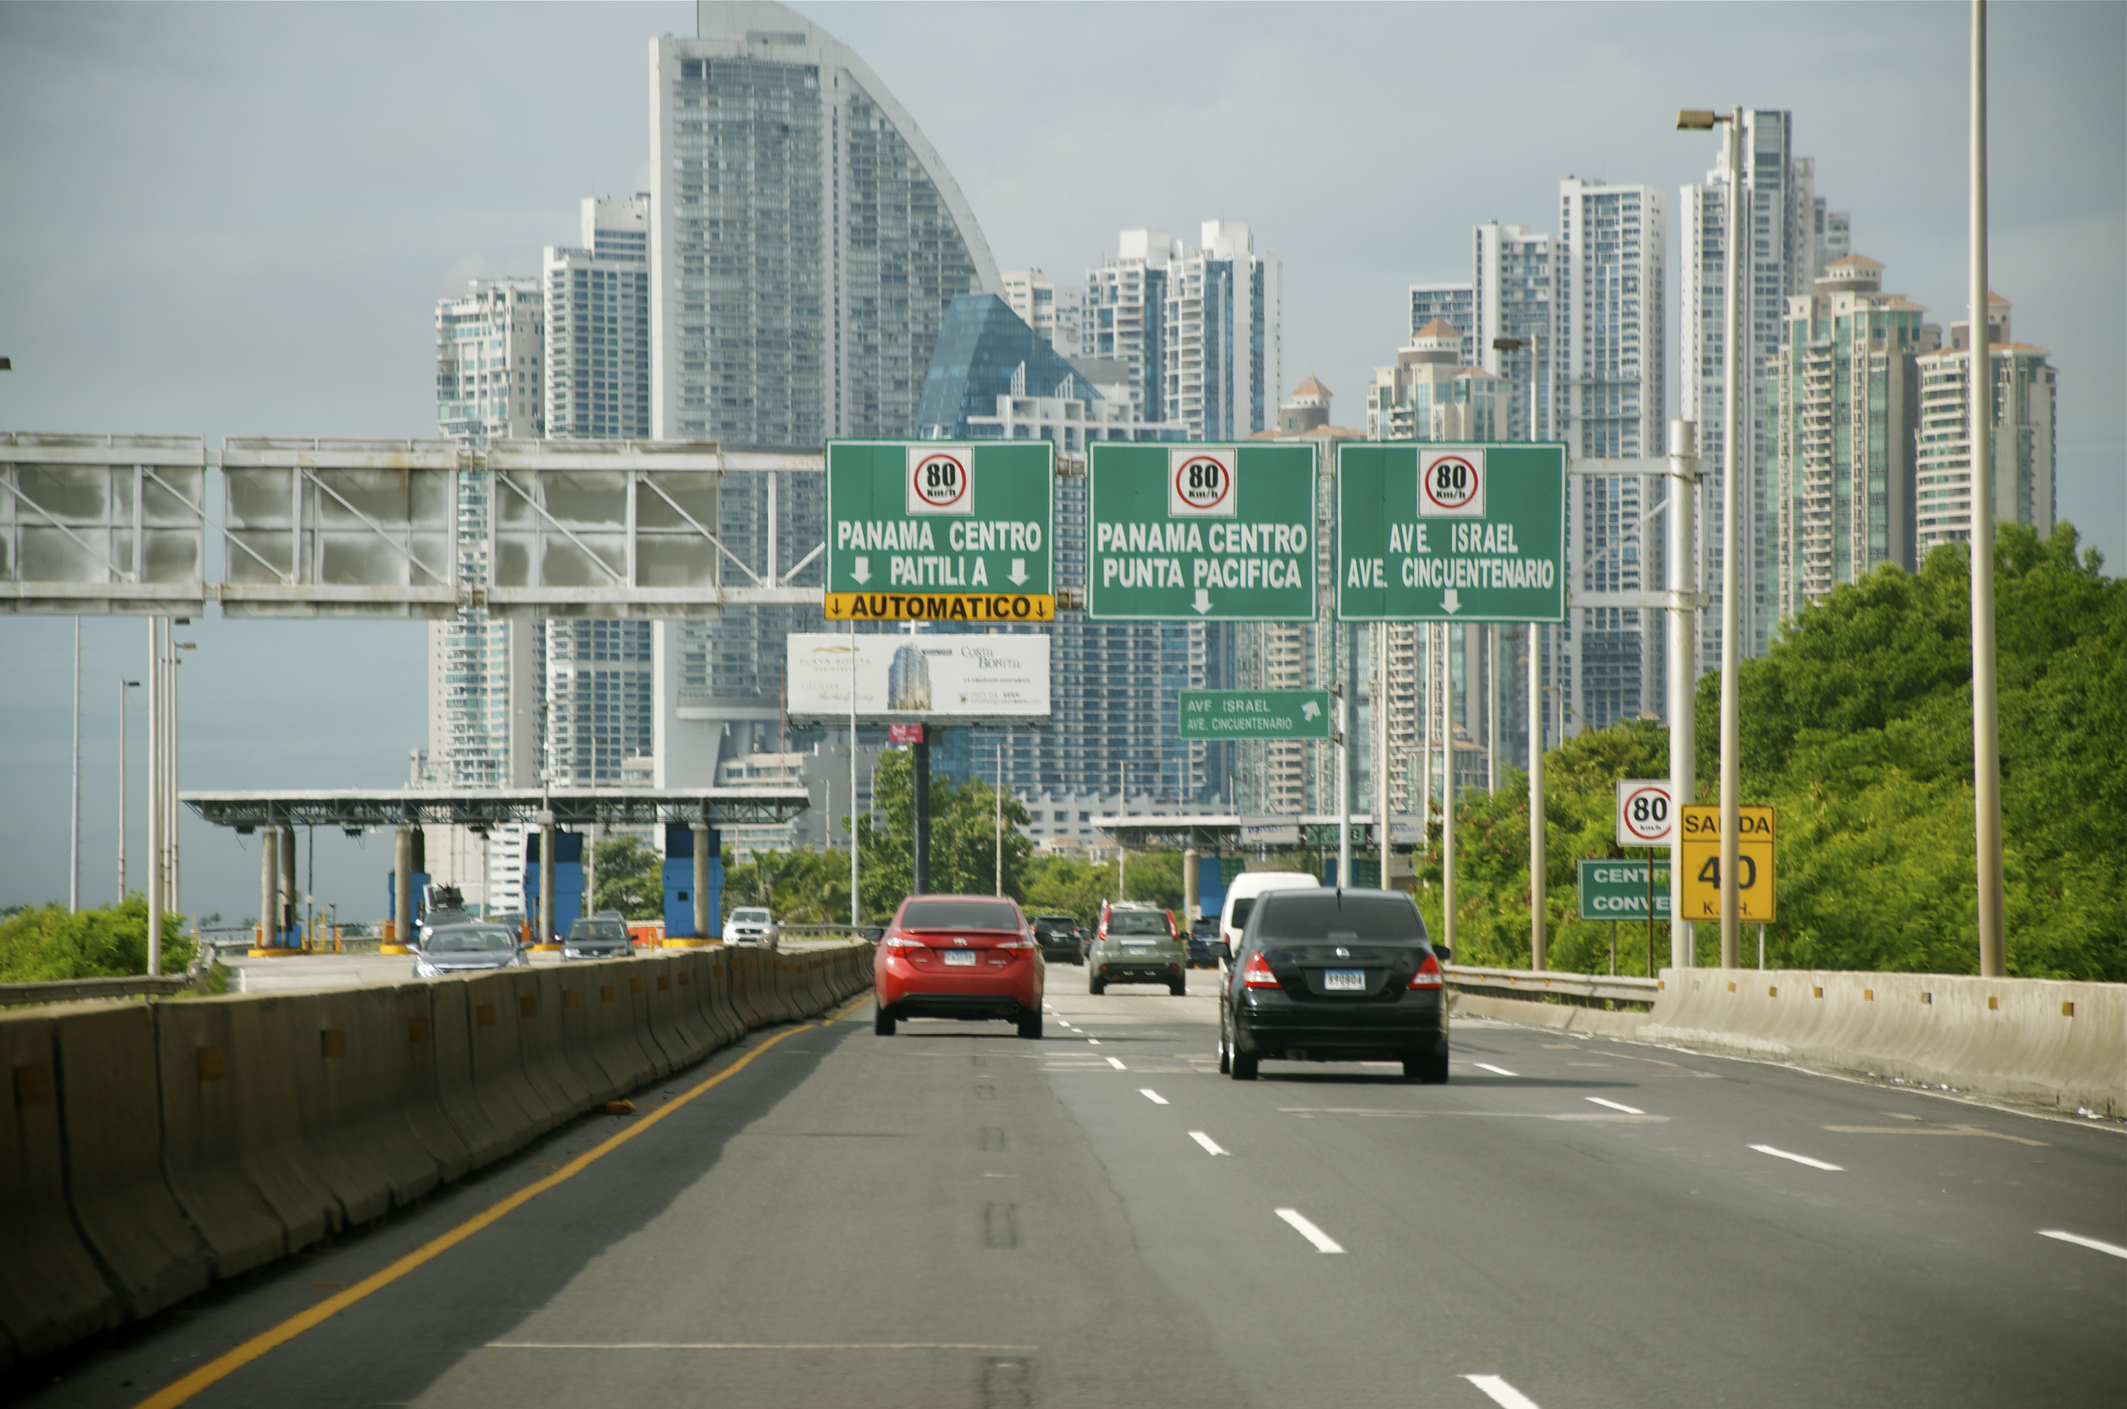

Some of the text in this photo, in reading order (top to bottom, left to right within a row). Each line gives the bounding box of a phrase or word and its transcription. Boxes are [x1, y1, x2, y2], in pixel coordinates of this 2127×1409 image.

[927, 462, 956, 487] 80
[1189, 464, 1219, 488] 80
[1437, 465, 1467, 489] 80
[1189, 489, 1218, 499] Km/h
[1437, 490, 1466, 500] Km/h
[837, 520, 1042, 552] PANAMA CENTRO
[1097, 522, 1308, 554] PANAMA CENTRO
[1389, 523, 1518, 554] AVE. ISRAEL
[1103, 558, 1302, 589] PUNTA PACIFICA
[1347, 557, 1555, 590] AVE. CINCUENTENARIO
[850, 595, 1031, 619] AUTOMATICO
[1223, 699, 1271, 713] ISRAEL
[1211, 717, 1292, 731] CINCUENTENARIO
[1634, 797, 1668, 822] 80
[1698, 855, 1757, 890] 40
[1592, 895, 1671, 911] CONVE
